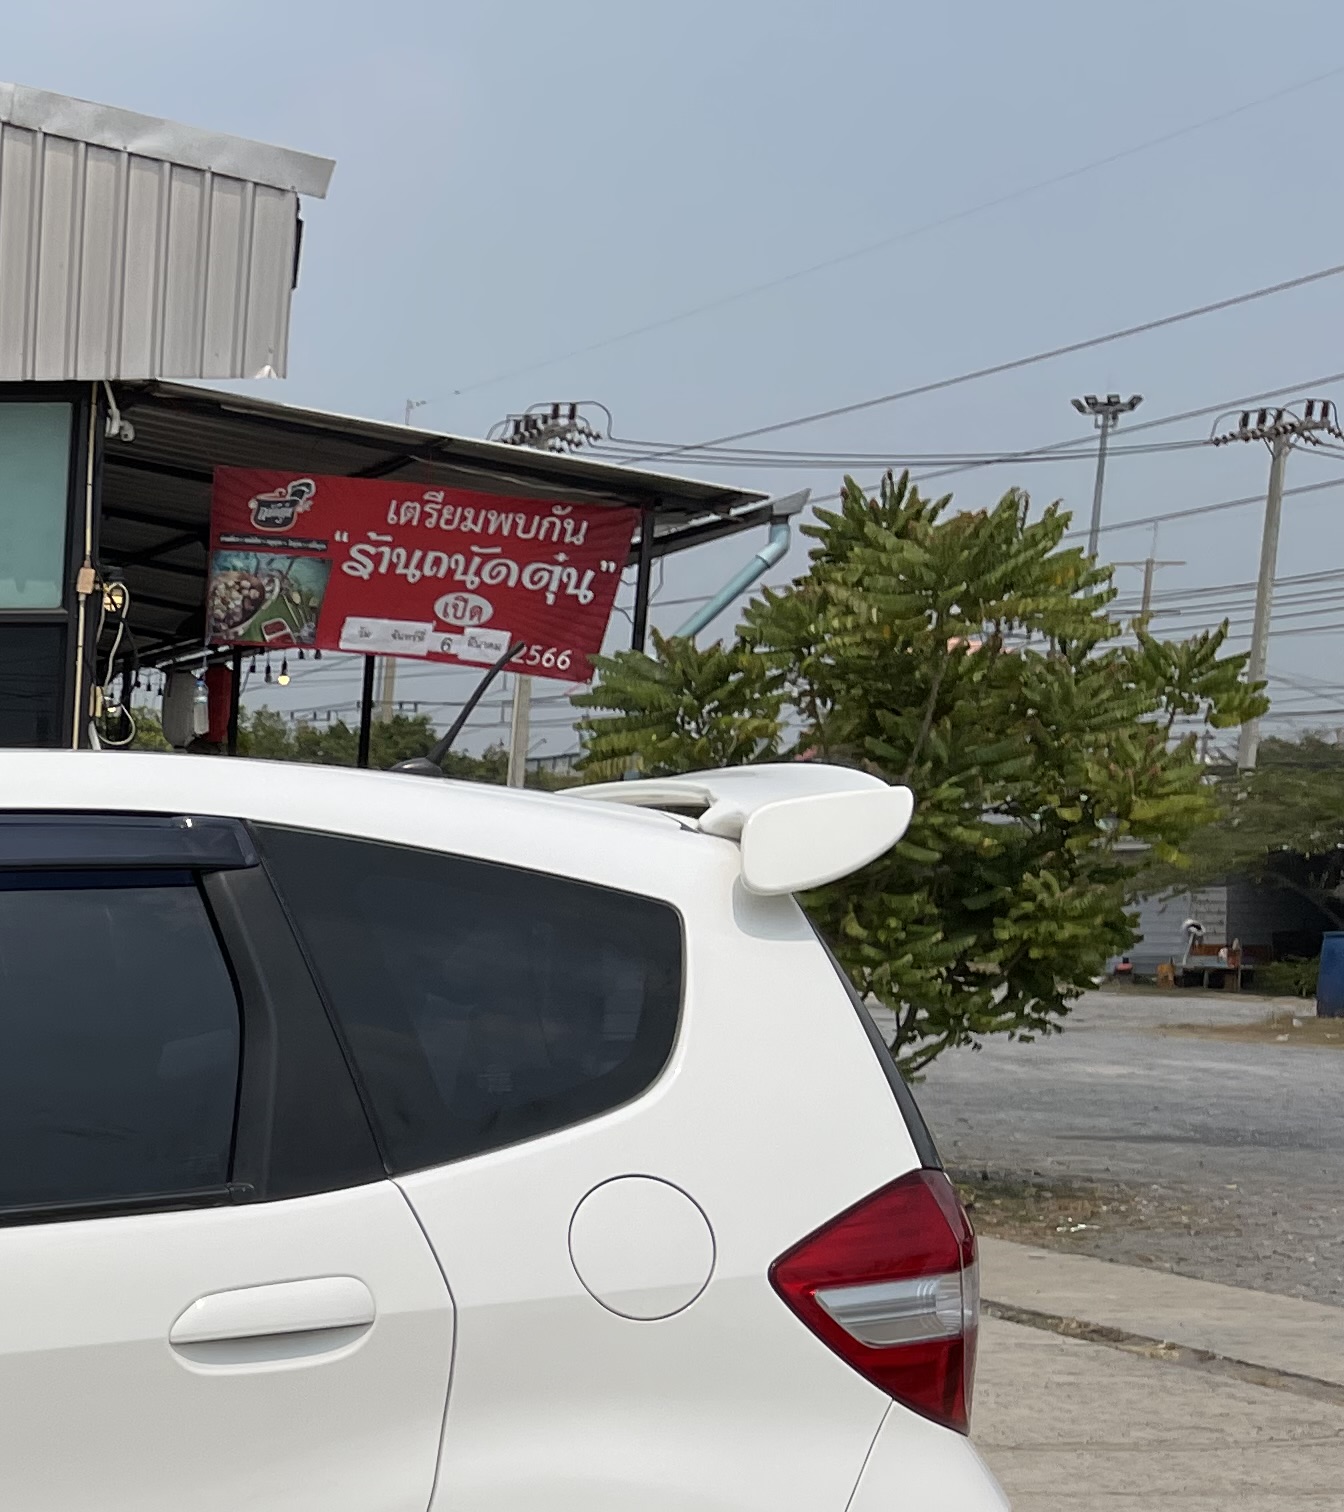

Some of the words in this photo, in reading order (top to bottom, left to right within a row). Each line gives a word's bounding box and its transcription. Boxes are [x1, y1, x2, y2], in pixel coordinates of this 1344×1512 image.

[387, 491, 588, 545] เตรียมพบกัน
[442, 595, 483, 624] เปิด
[439, 636, 453, 652] 6
